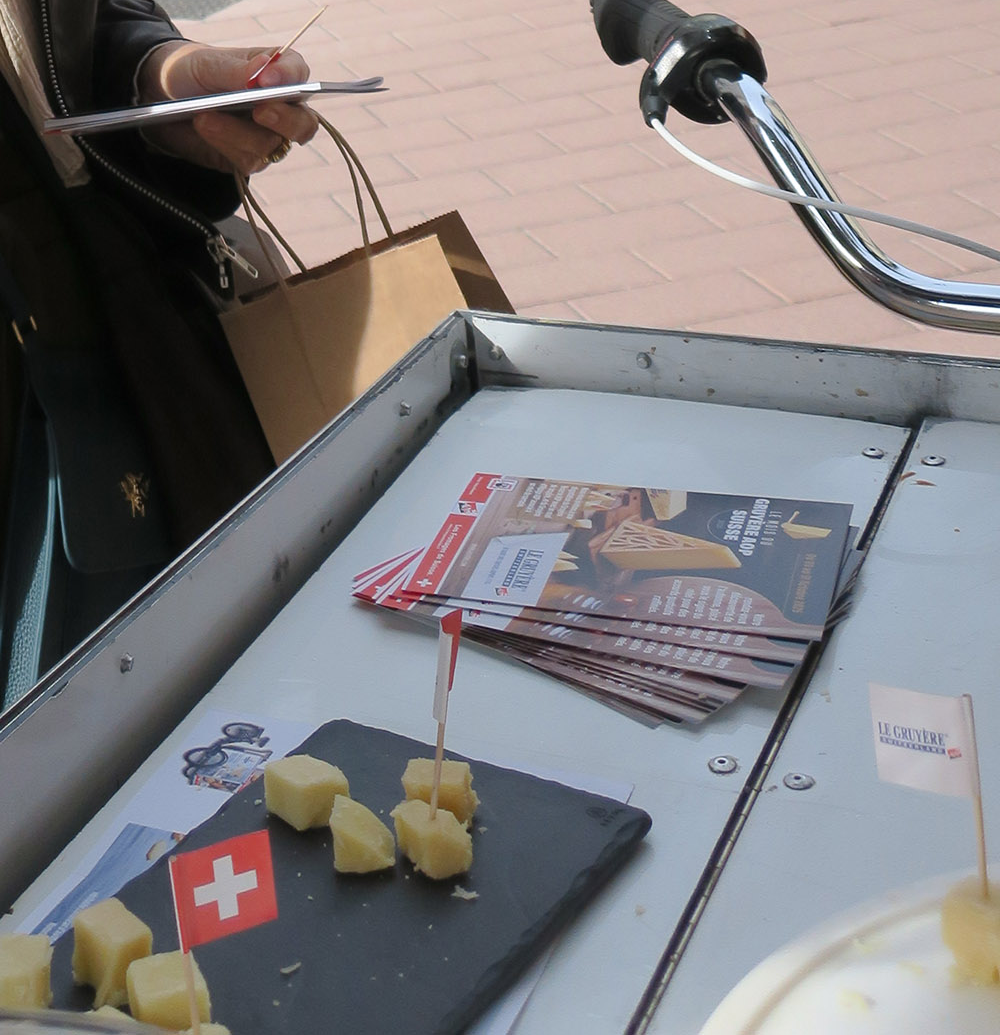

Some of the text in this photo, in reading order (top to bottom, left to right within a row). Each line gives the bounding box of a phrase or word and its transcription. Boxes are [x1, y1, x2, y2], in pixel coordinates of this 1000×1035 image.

[723, 509, 747, 541] SUISSE
[738, 498, 770, 556] GRUYÈRE AOP
[511, 549, 544, 589] LE GRUYÈRE
[878, 721, 945, 746] LE GRUYÈRE
